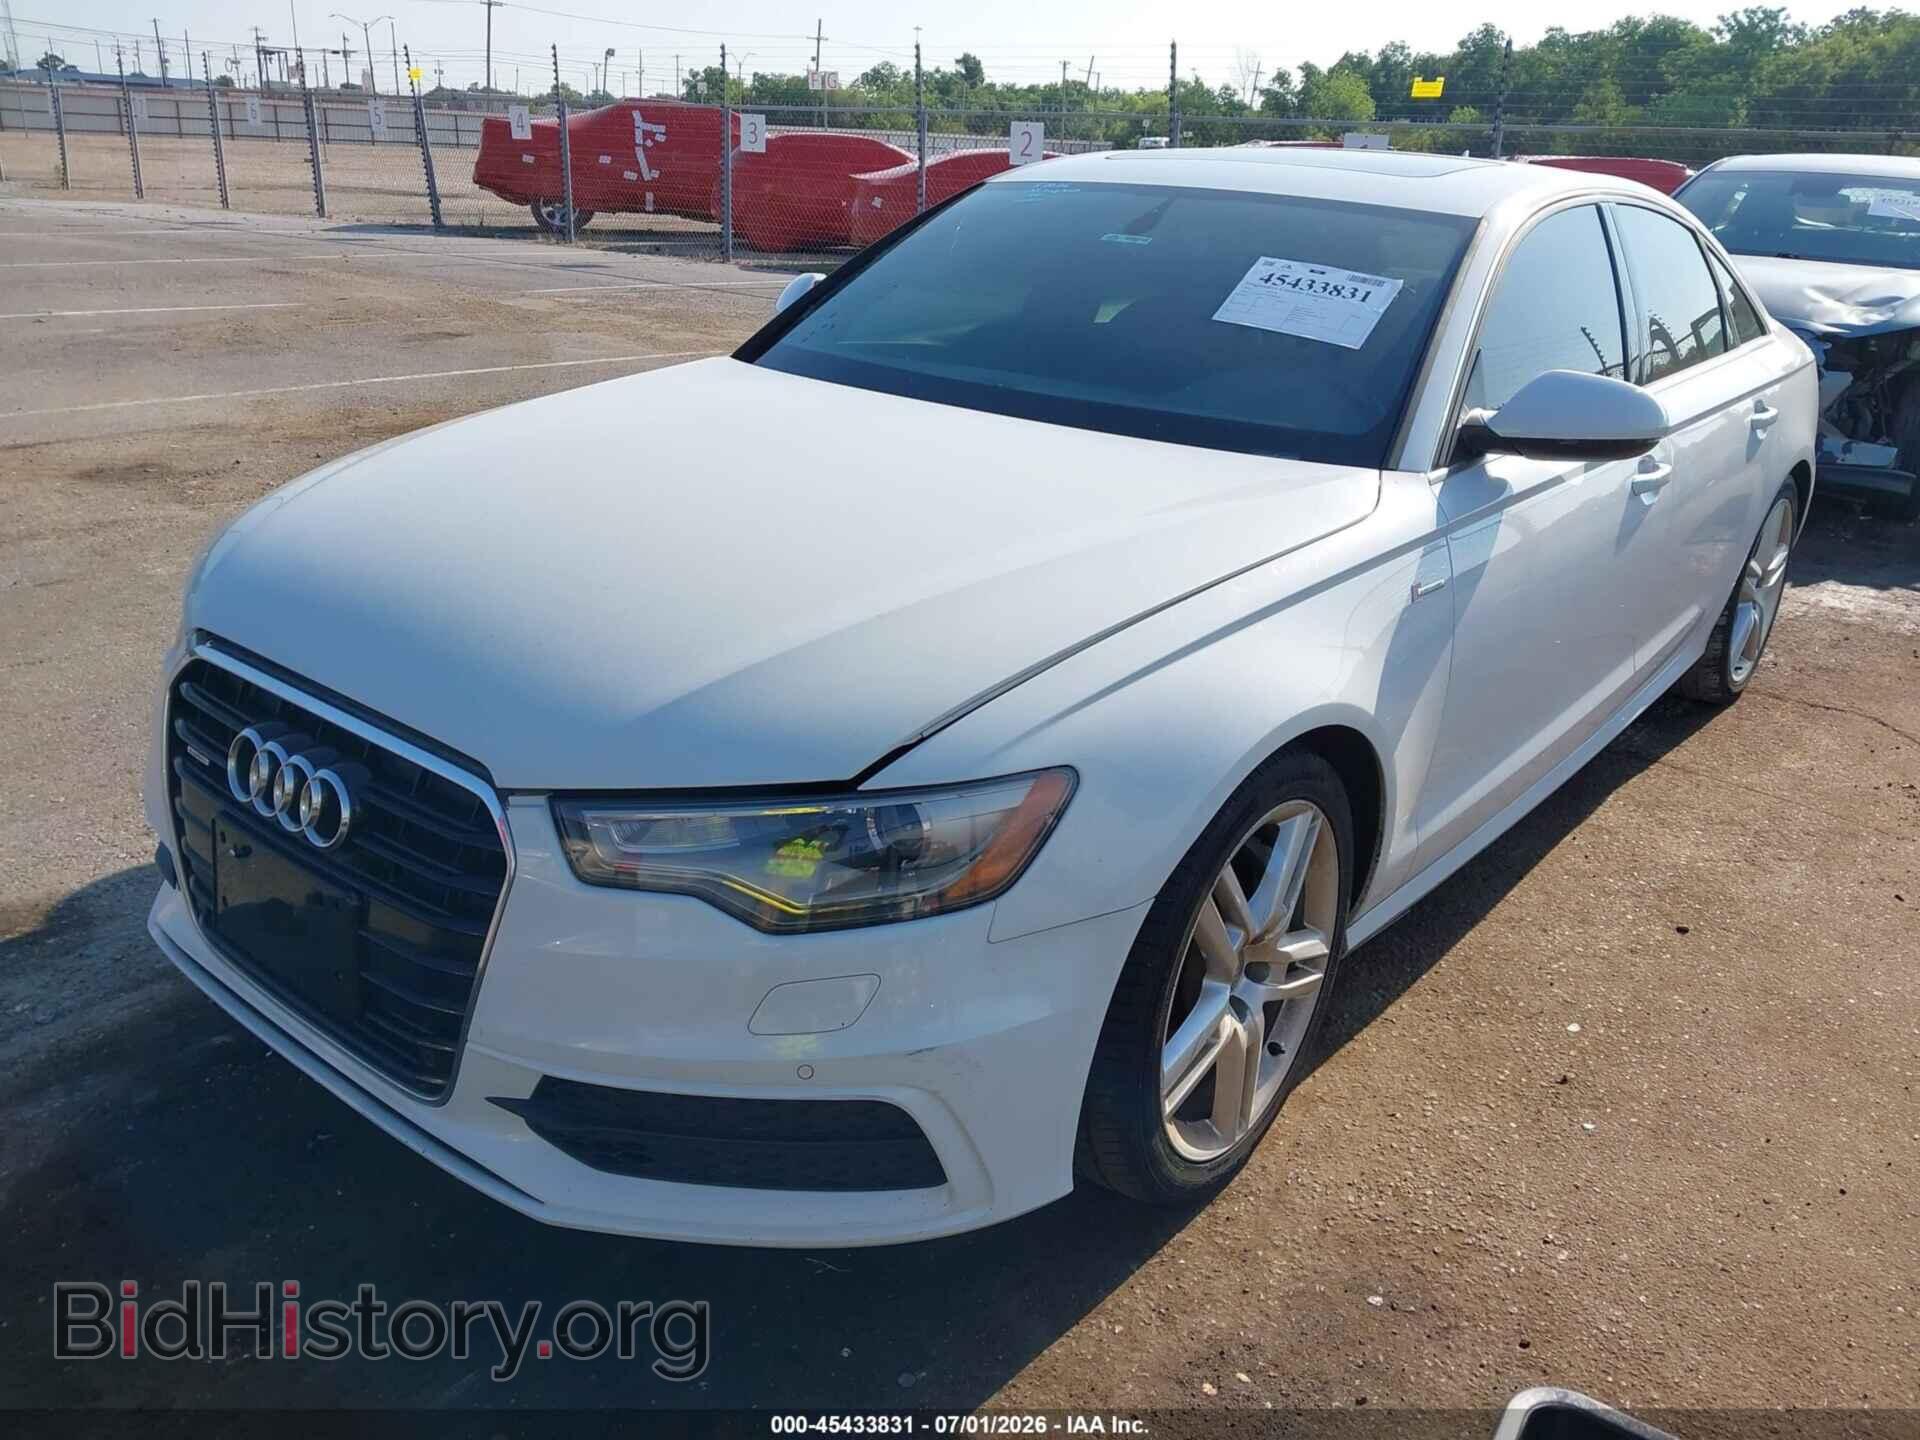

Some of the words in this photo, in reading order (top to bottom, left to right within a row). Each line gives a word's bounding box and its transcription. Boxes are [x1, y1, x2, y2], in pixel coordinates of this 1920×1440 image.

[373, 106, 382, 125] 5
[516, 112, 525, 132] 4
[748, 121, 758, 144] 3
[1020, 131, 1032, 157] 2
[1259, 273, 1371, 302] 45433831
